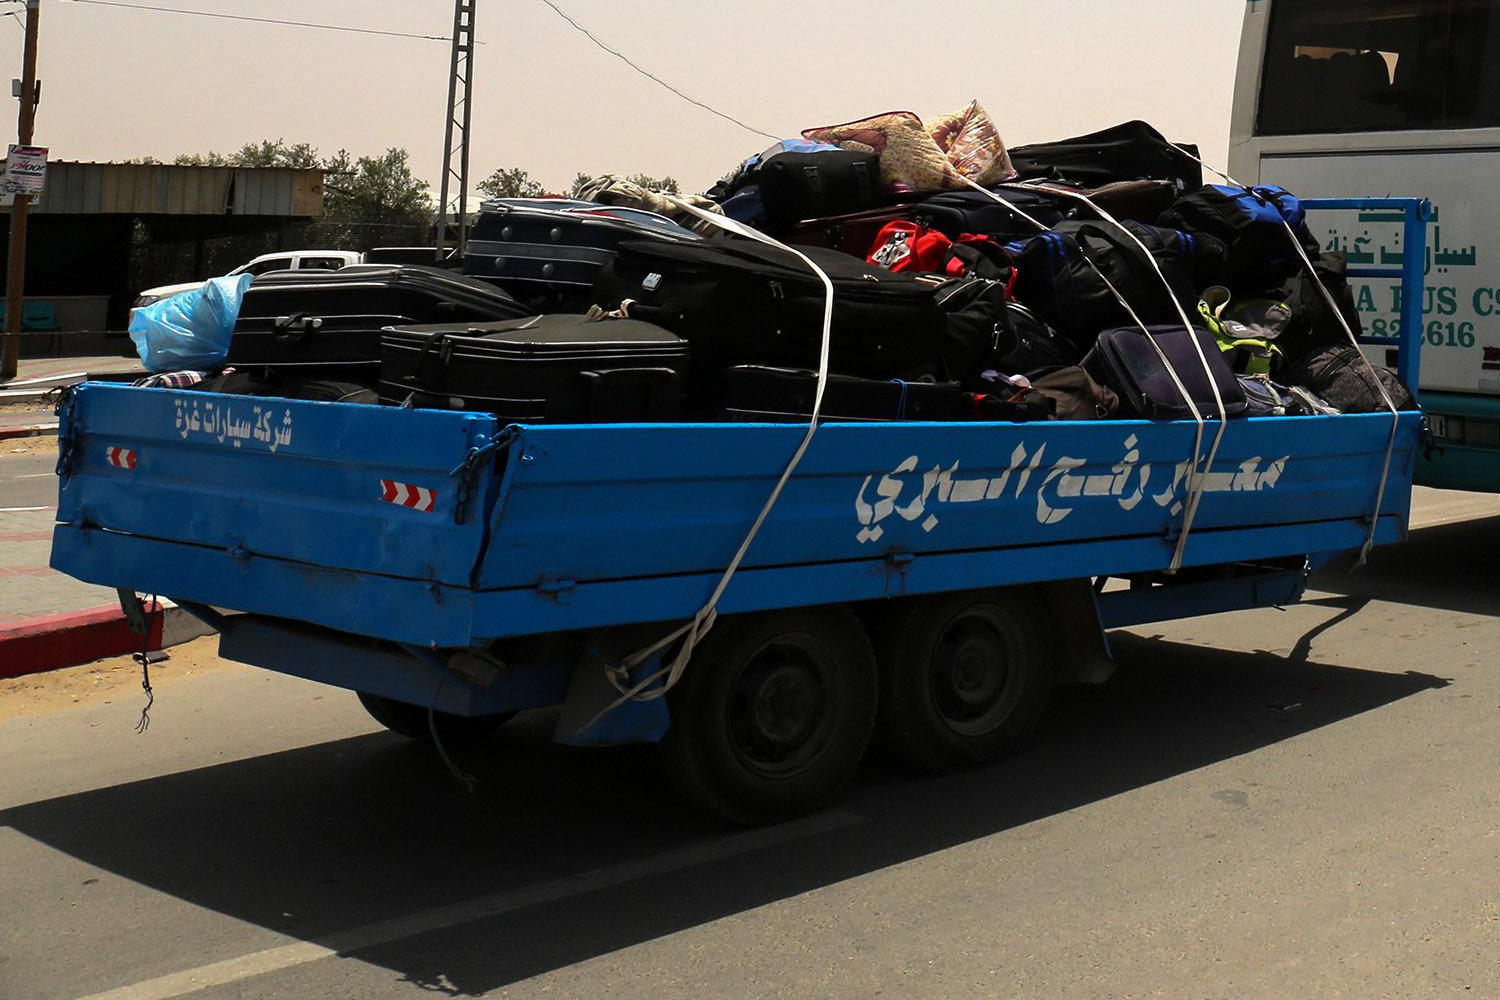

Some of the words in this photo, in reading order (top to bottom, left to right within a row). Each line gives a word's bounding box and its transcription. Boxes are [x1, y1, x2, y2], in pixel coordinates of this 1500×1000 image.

[174, 399, 200, 439] غزة
[203, 402, 250, 449] سيارات
[253, 405, 292, 453] شركة
[854, 440, 1047, 544] البري
[1036, 433, 1151, 525] رفح
[1152, 454, 1290, 517] معبر
